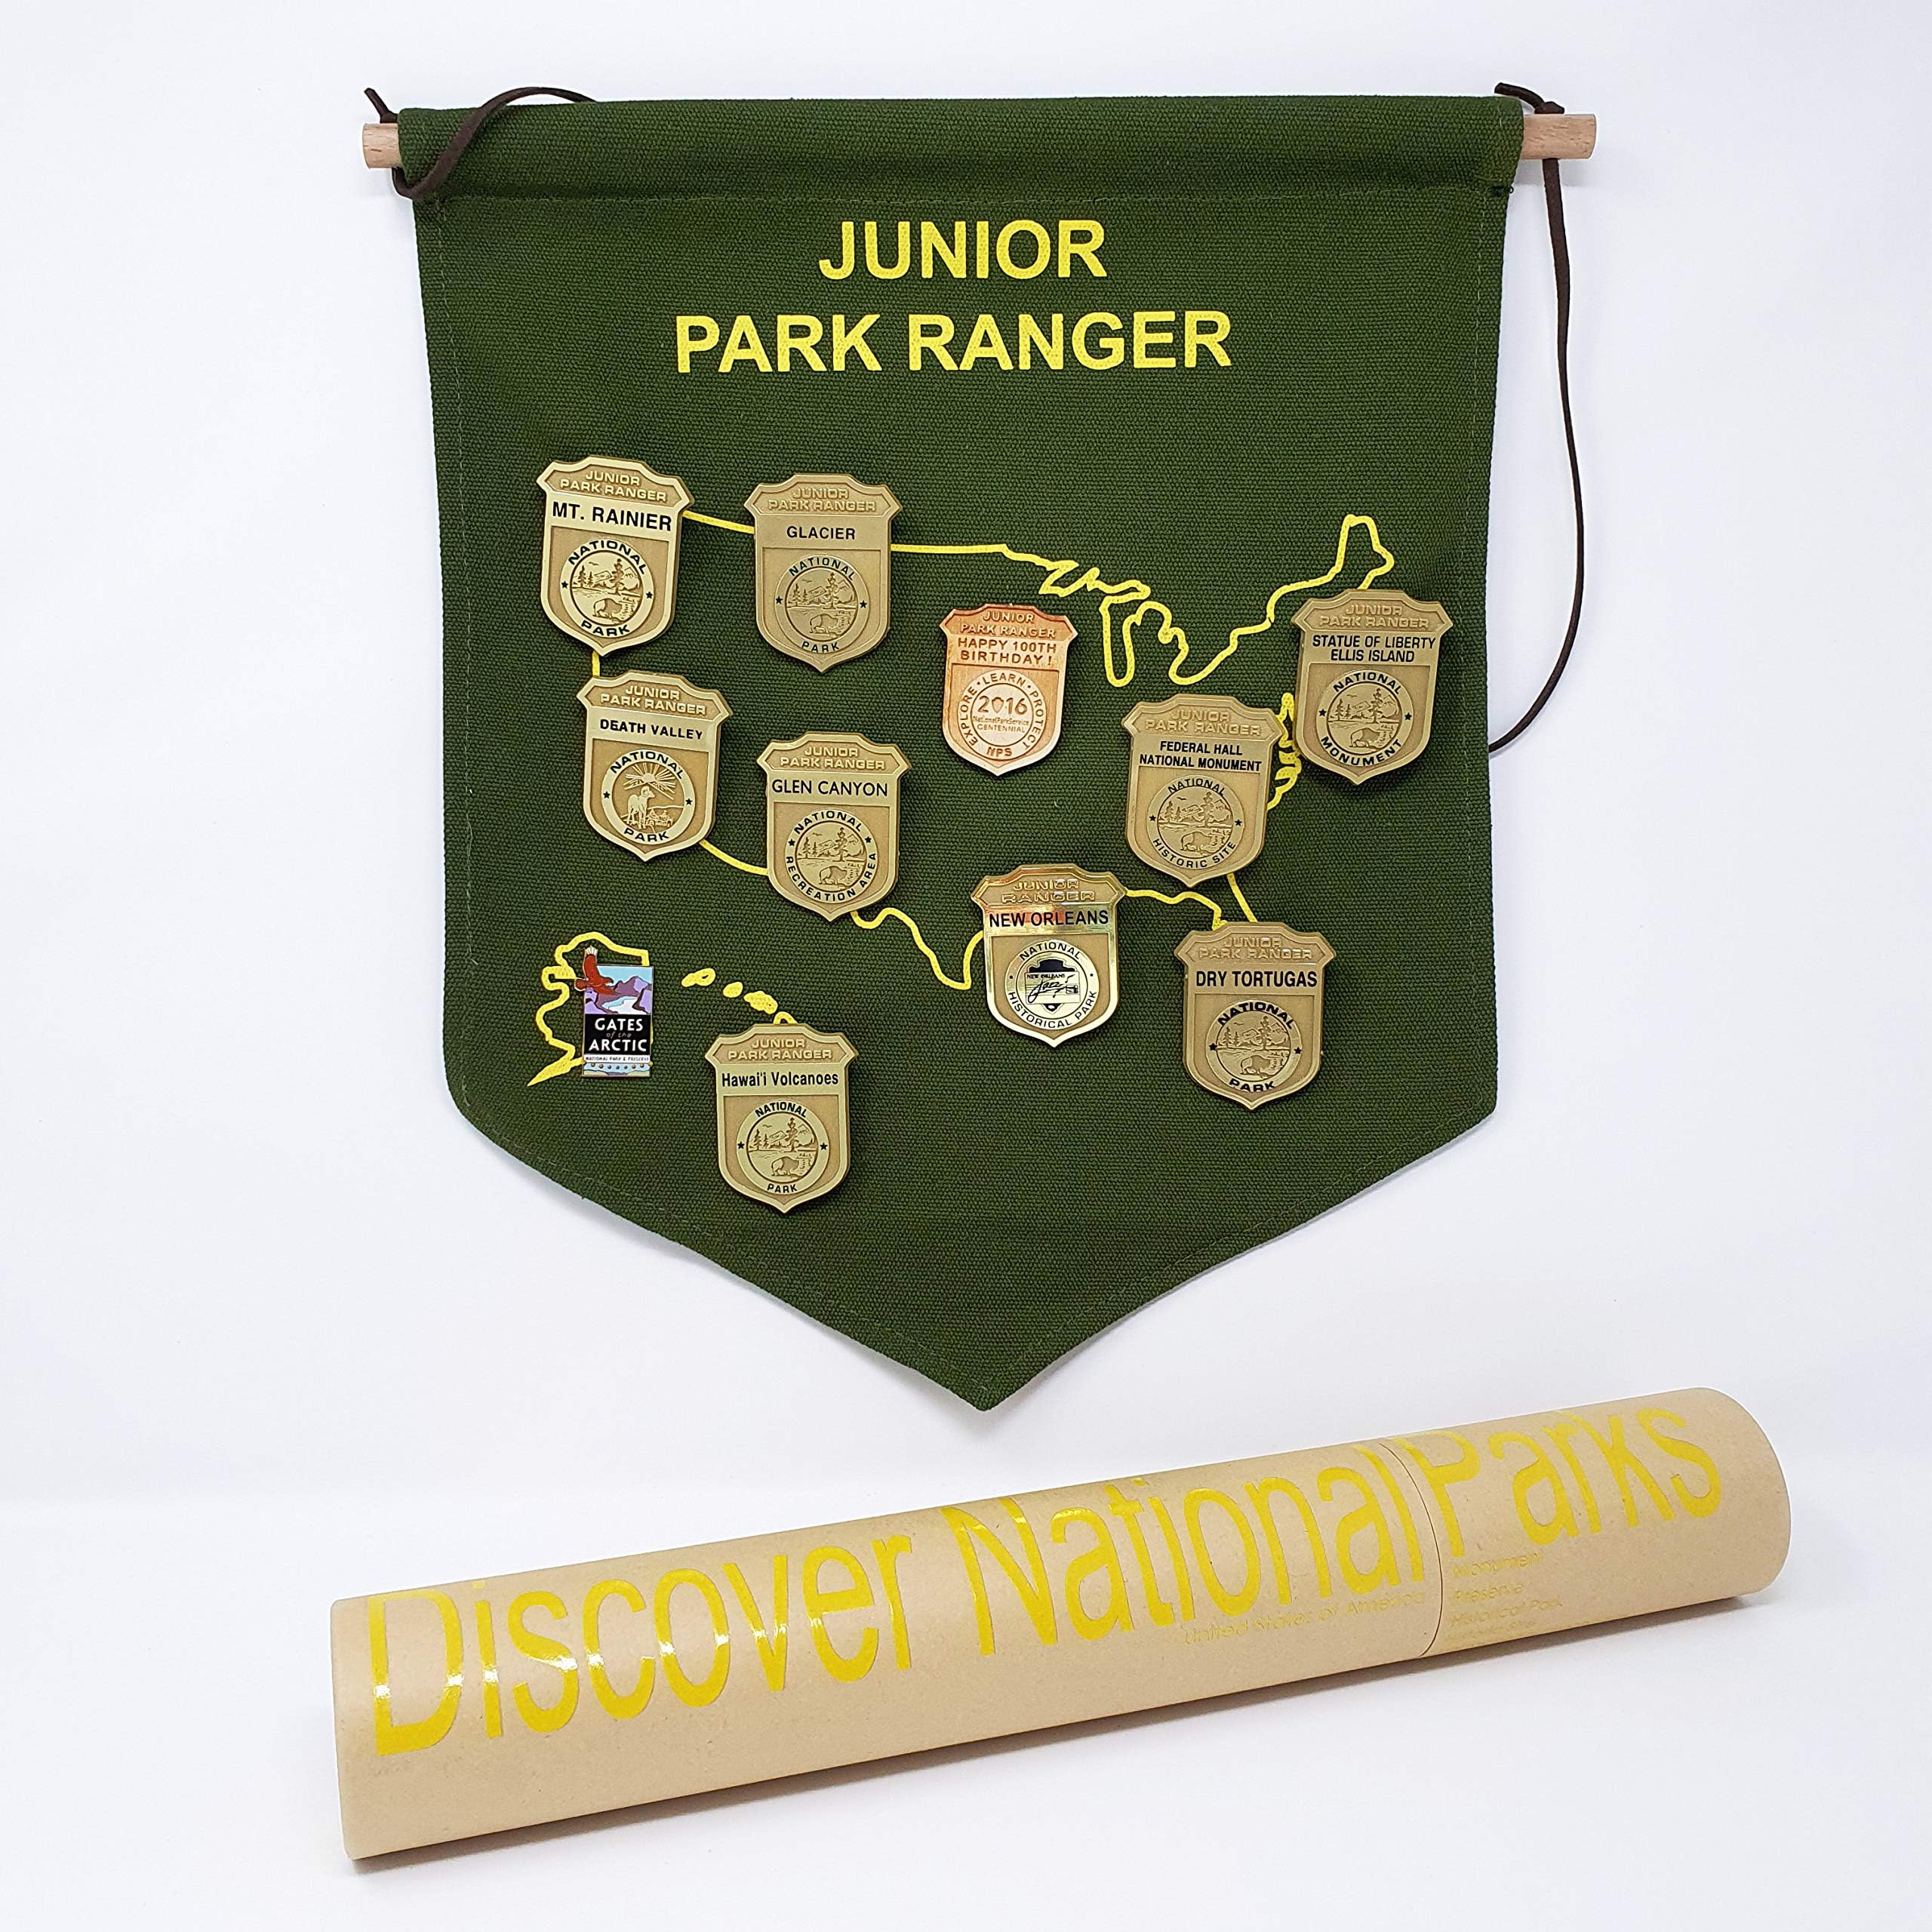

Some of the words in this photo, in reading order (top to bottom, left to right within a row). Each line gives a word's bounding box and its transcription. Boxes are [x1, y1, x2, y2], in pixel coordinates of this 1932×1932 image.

[819, 220, 1107, 280] JUNIOR
[676, 313, 882, 373] PARK
[909, 310, 1232, 371] RANGER
[585, 470, 641, 486] JUNIOR
[560, 478, 601, 494] PARK
[605, 485, 667, 502] RANGER
[792, 488, 849, 499] JUNIOR
[768, 500, 810, 511] PARK
[813, 500, 875, 512] RANGER
[553, 501, 585, 520] MT.
[592, 506, 672, 531] RAINIER
[786, 525, 856, 540] GLACIER
[568, 540, 648, 575] NATIONAL
[789, 557, 855, 581] NATIONAL
[983, 611, 1035, 623] JUNIOR
[1346, 605, 1403, 616] JUNIOR
[580, 619, 630, 636] PARK
[1319, 615, 1361, 626] PARK
[1365, 617, 1429, 629] RANGER
[960, 623, 995, 635] PARK
[1000, 625, 1056, 638] RANGER
[801, 641, 840, 653] PARK
[958, 637, 1008, 650] HAPPY
[1013, 641, 1057, 653] 100TH
[1312, 635, 1361, 648] STATUE
[1364, 635, 1380, 648] OF
[1385, 636, 1436, 649] LIBERTY
[1331, 649, 1364, 662] ELLIS
[1368, 650, 1414, 663] ISLAND
[982, 672, 1026, 687] LEARN
[1333, 672, 1402, 695] NATIONAL
[626, 685, 680, 700] JUNIOR
[601, 694, 641, 708] PARK
[645, 698, 706, 715] RANGER
[977, 695, 1028, 715] 2016
[959, 686, 979, 746] EXPLORE
[1023, 690, 1044, 749] PROTECT
[1171, 709, 1231, 722] JUNIOR
[600, 718, 646, 734] DEATH
[651, 724, 703, 740] VALLEY
[977, 724, 1026, 733] CENTENNIAL
[1145, 719, 1187, 732] PARK
[1194, 722, 1263, 736] RANGER
[804, 746, 859, 758] JUNIOR
[986, 746, 1012, 757] NPS
[1160, 741, 1211, 754] FEDERAL
[1214, 744, 1243, 755] HALL
[1321, 736, 1402, 766] MONUMENT
[610, 751, 685, 780] NATIONAL
[780, 757, 820, 768] PARK
[824, 758, 886, 771] RANGER
[1140, 754, 1195, 768] NATIONAL
[1198, 758, 1262, 771] MONUMENT
[772, 779, 812, 794] GLEN
[817, 780, 888, 797] CANYON
[1168, 778, 1226, 796] NATIONAL
[794, 810, 862, 835] NATIONAL
[623, 829, 669, 842] PARK
[1153, 838, 1208, 869] HISTORIC
[1213, 843, 1236, 863] SITE
[786, 856, 857, 902] RECREATION
[860, 852, 876, 888] AREA
[1013, 879, 1079, 891] JUNIOR
[1001, 891, 1095, 903] RANGER
[989, 913, 1026, 928] NEW
[1031, 909, 1109, 927] ORLEANS
[1224, 937, 1281, 948] JUNIOR
[1020, 942, 1081, 961] NATIONAL
[1199, 948, 1241, 958] PARK
[1247, 948, 1312, 959] RANGER
[1196, 971, 1227, 986] DRY
[1232, 971, 1318, 987] TORTUGAS
[1008, 991, 1073, 1029] HISTORICAL
[1076, 990, 1097, 1020] PARK
[1217, 1001, 1295, 1029] NATIONAL
[595, 1018, 643, 1031] GATES
[589, 1039, 647, 1051] ARCTIC
[752, 1038, 805, 1049] JUNIOR
[728, 1050, 768, 1060] PARK
[771, 1049, 832, 1060] RANGER
[721, 1072, 767, 1087] Hawai'i
[771, 1071, 838, 1087] Volcanoes
[1229, 1078, 1275, 1092] PARK
[755, 1101, 808, 1118] NATIONAL
[767, 1183, 798, 1193] PARK
[368, 1534, 912, 1757] Discover
[940, 1444, 1425, 1646] National
[1393, 1409, 1722, 1558] Parks
[1183, 1619, 1247, 1645] United
